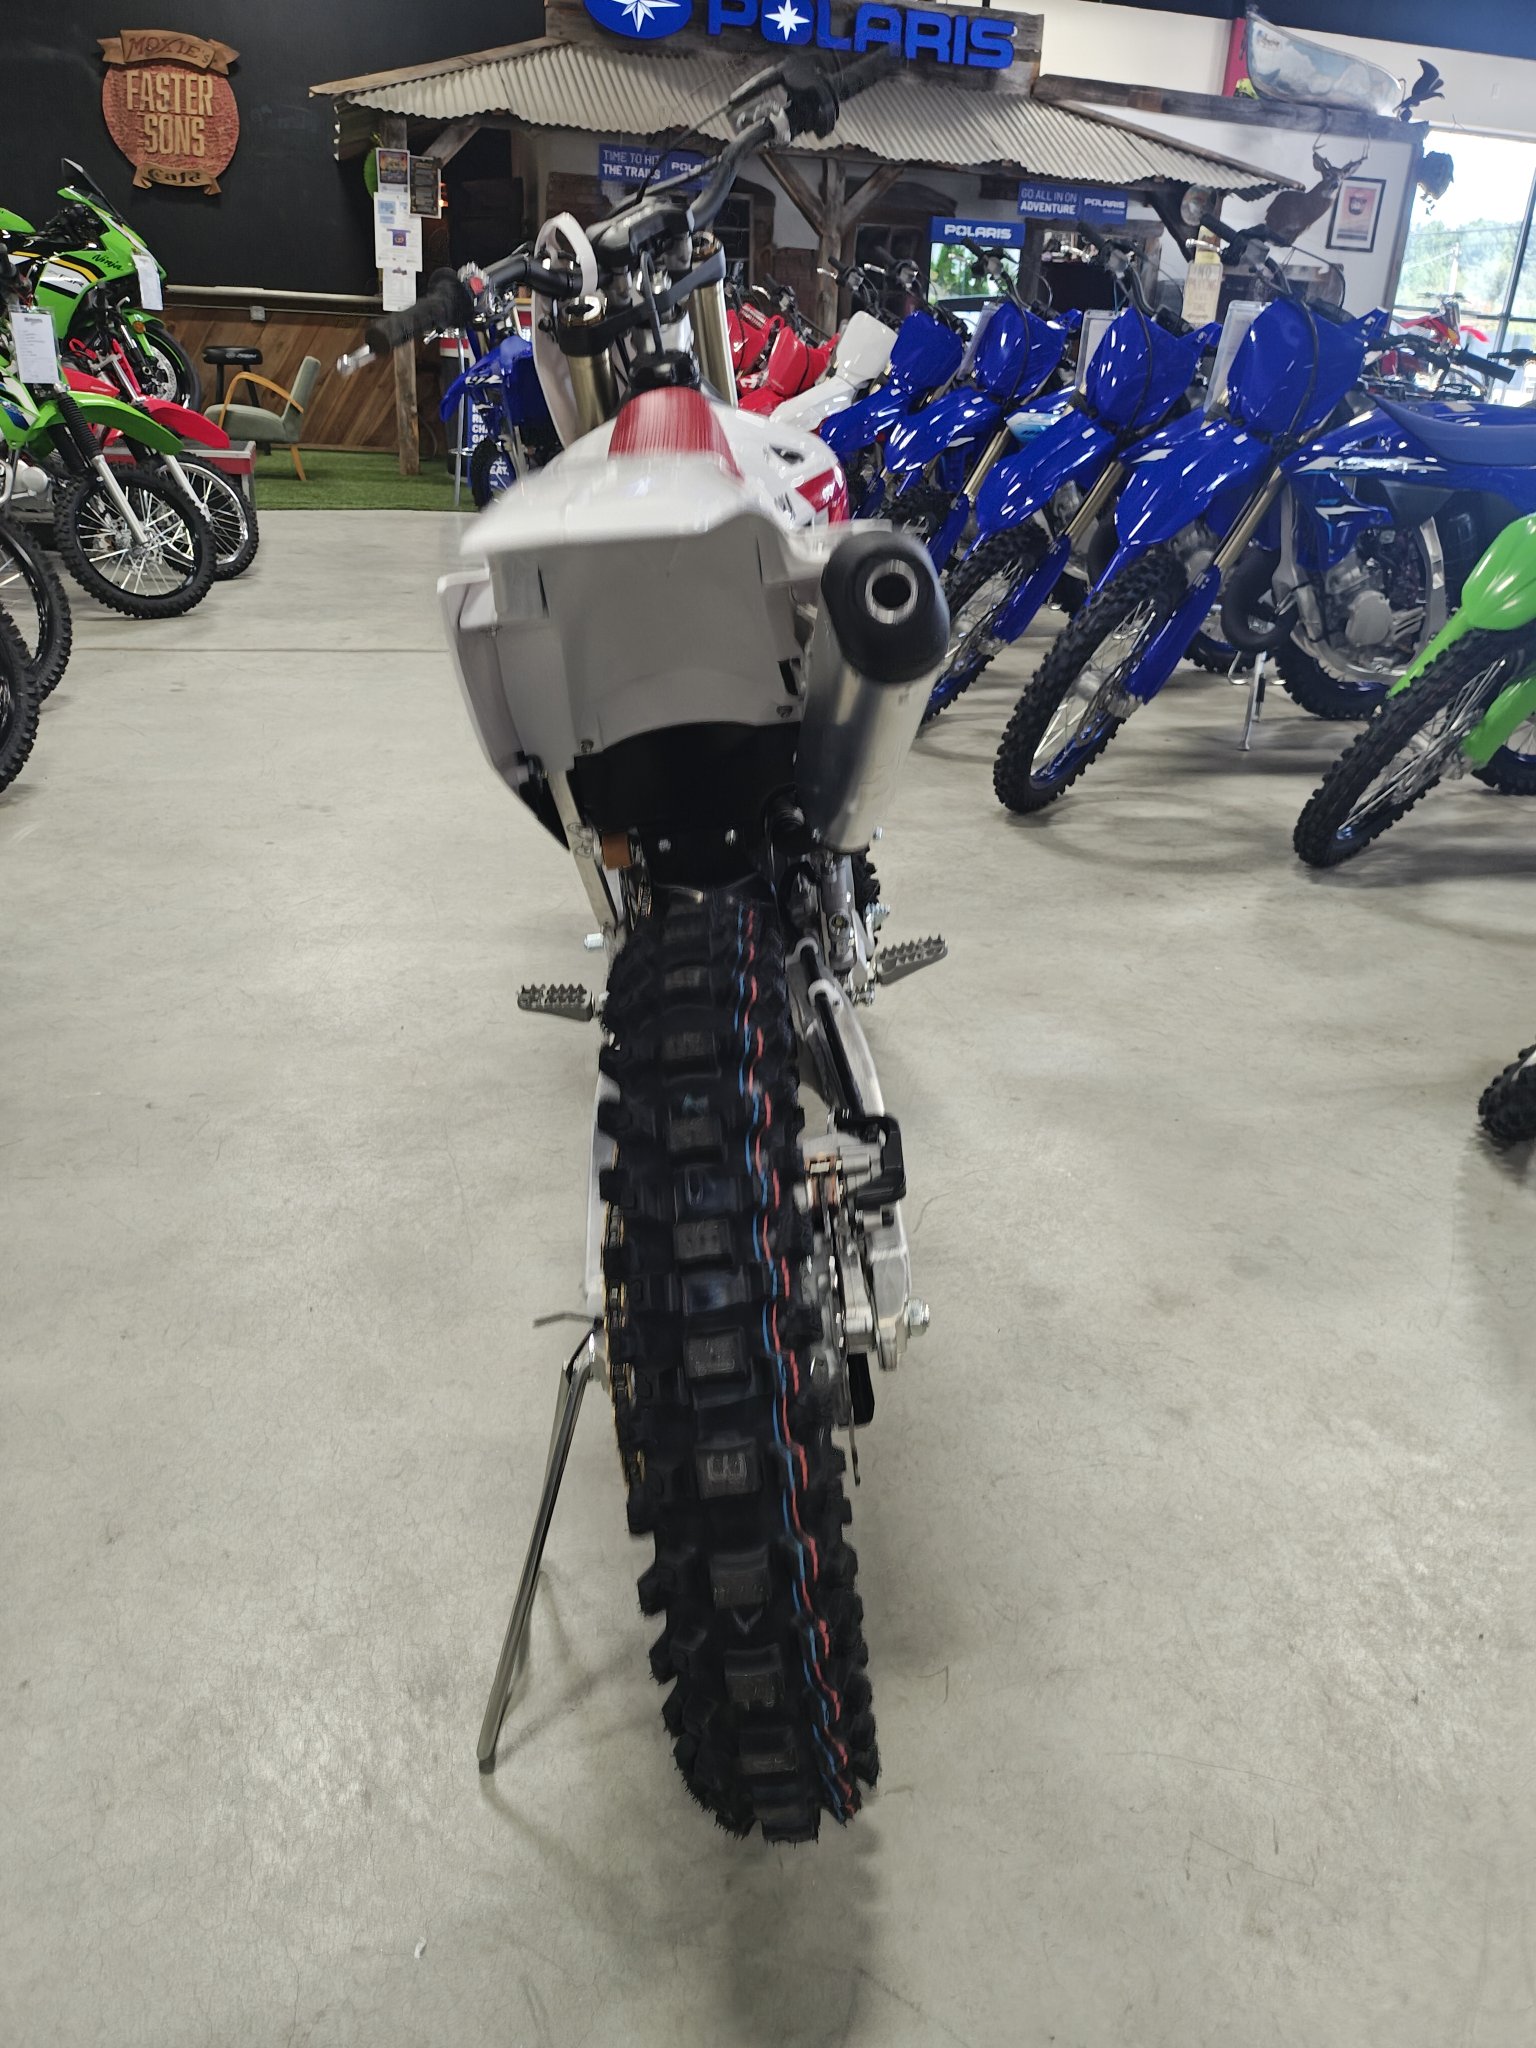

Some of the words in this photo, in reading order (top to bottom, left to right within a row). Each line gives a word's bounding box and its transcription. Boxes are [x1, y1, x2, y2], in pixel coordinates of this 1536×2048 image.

[706, 0, 1015, 69] POLARIS
[125, 70, 214, 117] FASTER
[143, 114, 210, 157] SONS
[603, 149, 627, 163] TIME
[630, 153, 642, 165] TO
[602, 163, 622, 176] THE
[624, 165, 660, 180] TRAIS
[1020, 187, 1034, 200] GO
[1035, 189, 1052, 202] ALL
[1053, 191, 1064, 202] IN
[1064, 191, 1078, 204] ON
[1084, 197, 1125, 209] POLARIS
[1020, 200, 1076, 215] ADVENTURE
[944, 224, 1012, 240] POLARIS
[92, 254, 124, 271] Ninja
